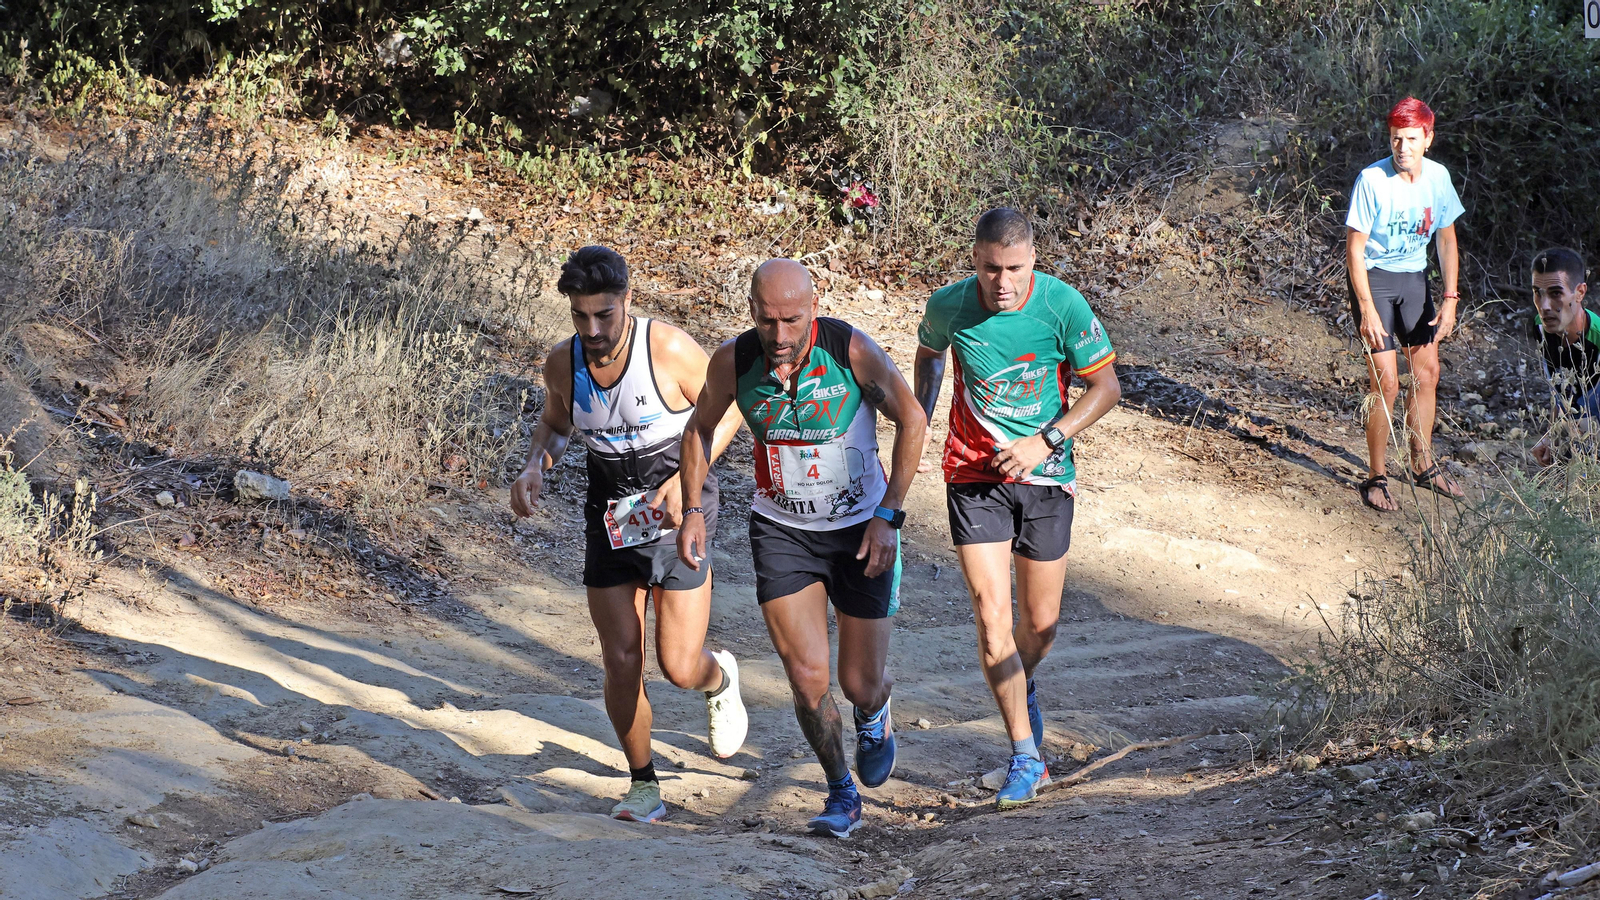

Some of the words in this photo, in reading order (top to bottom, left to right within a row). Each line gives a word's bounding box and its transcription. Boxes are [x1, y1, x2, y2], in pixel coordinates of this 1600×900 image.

[1021, 366, 1048, 380] BIKES
[813, 383, 847, 399] BIKES
[1013, 401, 1042, 418] BIKES
[801, 426, 840, 441] BIKES
[771, 453, 783, 490] PIRATA
[806, 464, 820, 480] 4
[628, 508, 664, 526] 416
